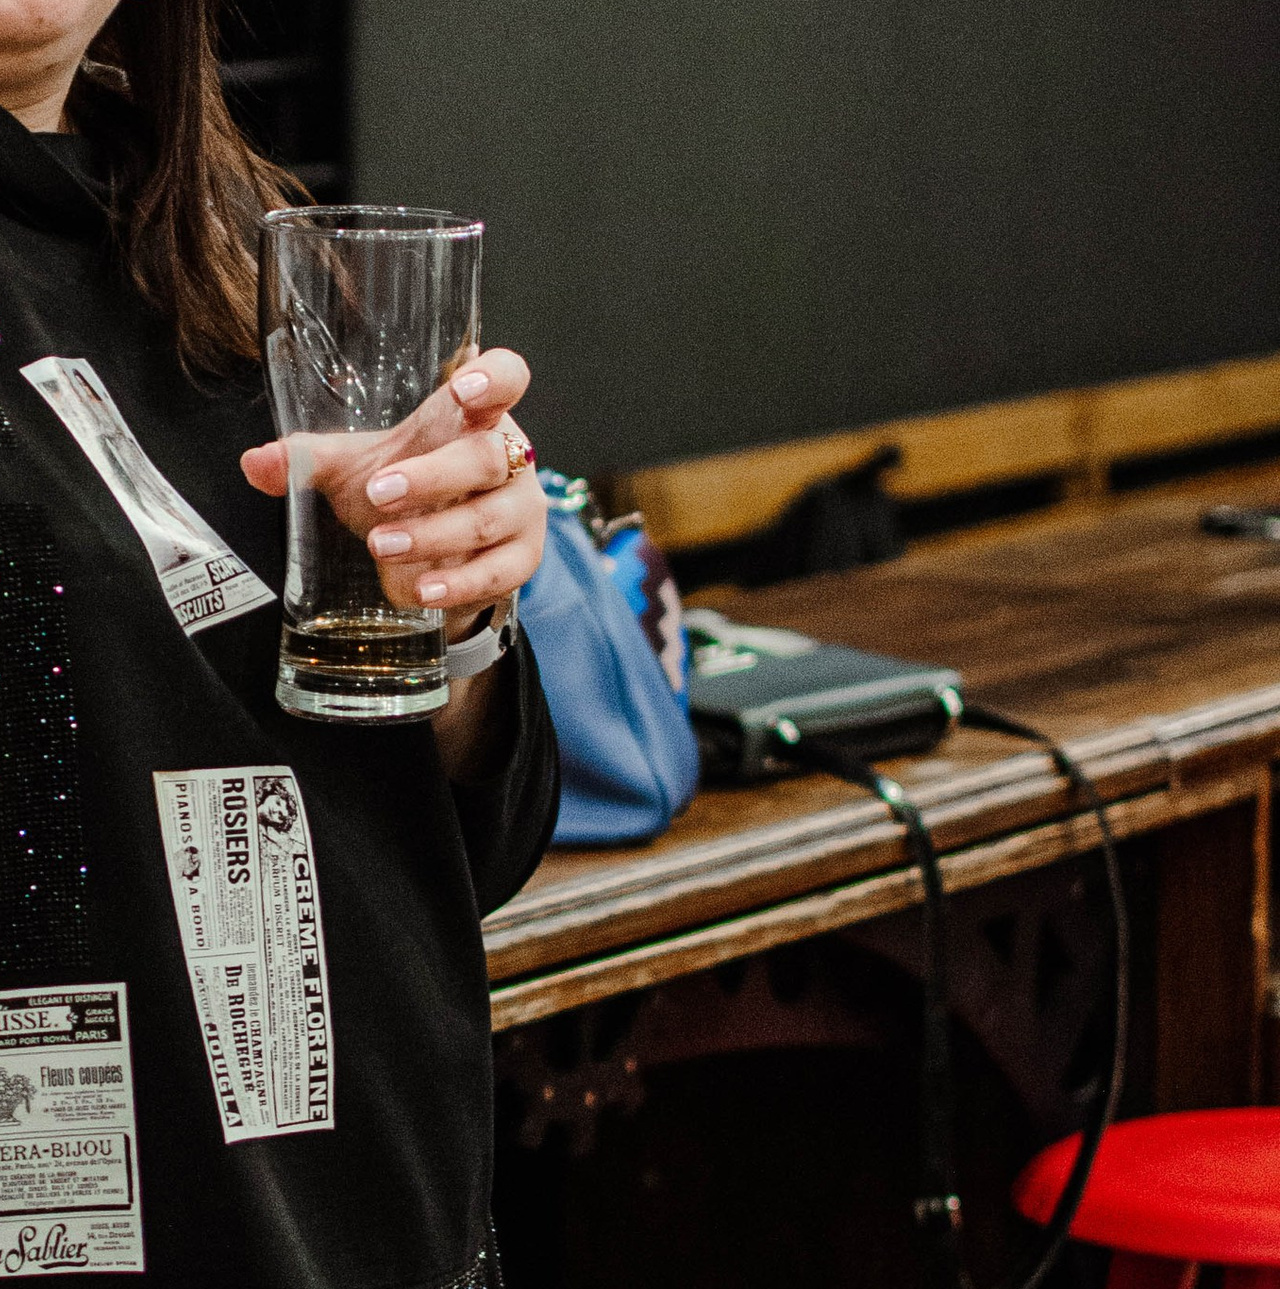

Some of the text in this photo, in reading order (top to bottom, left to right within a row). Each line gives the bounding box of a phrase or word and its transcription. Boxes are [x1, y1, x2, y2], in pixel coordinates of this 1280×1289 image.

[175, 783, 193, 844] PIANOS
[222, 778, 250, 885] ROSIERS
[191, 905, 205, 947] BORD
[271, 855, 284, 947] PARFUM DISCRET
[247, 963, 259, 1006] Demandez
[19, 1037, 40, 1045] PORT
[75, 1029, 108, 1041] PARIS
[40, 1062, 124, 1087] Fleurs coupées
[205, 1026, 242, 1125] JOUGLA
[5, 1223, 89, 1273] Sablier
